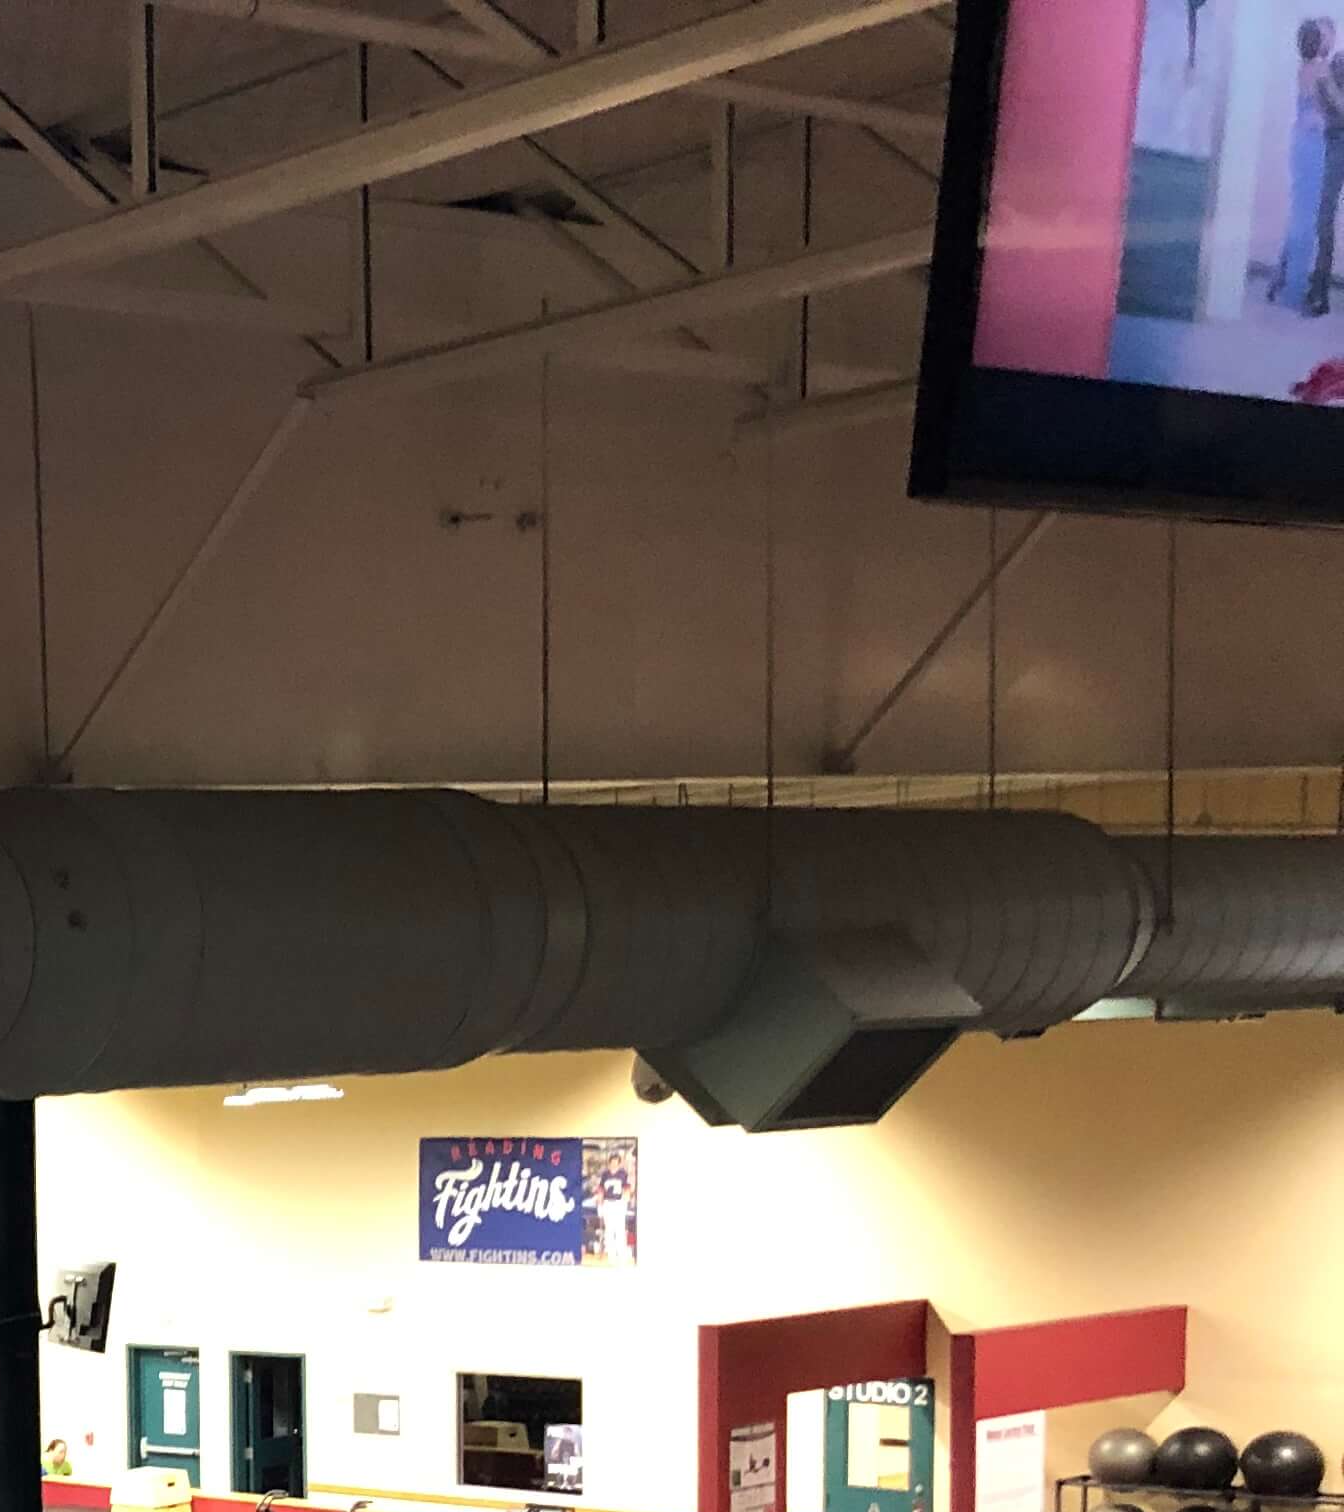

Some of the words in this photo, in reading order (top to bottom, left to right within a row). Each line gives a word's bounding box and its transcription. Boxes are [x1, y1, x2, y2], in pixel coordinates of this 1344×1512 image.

[451, 1138, 561, 1167] READING
[433, 1158, 575, 1247] Fightins
[914, 1384, 929, 1406] 2
